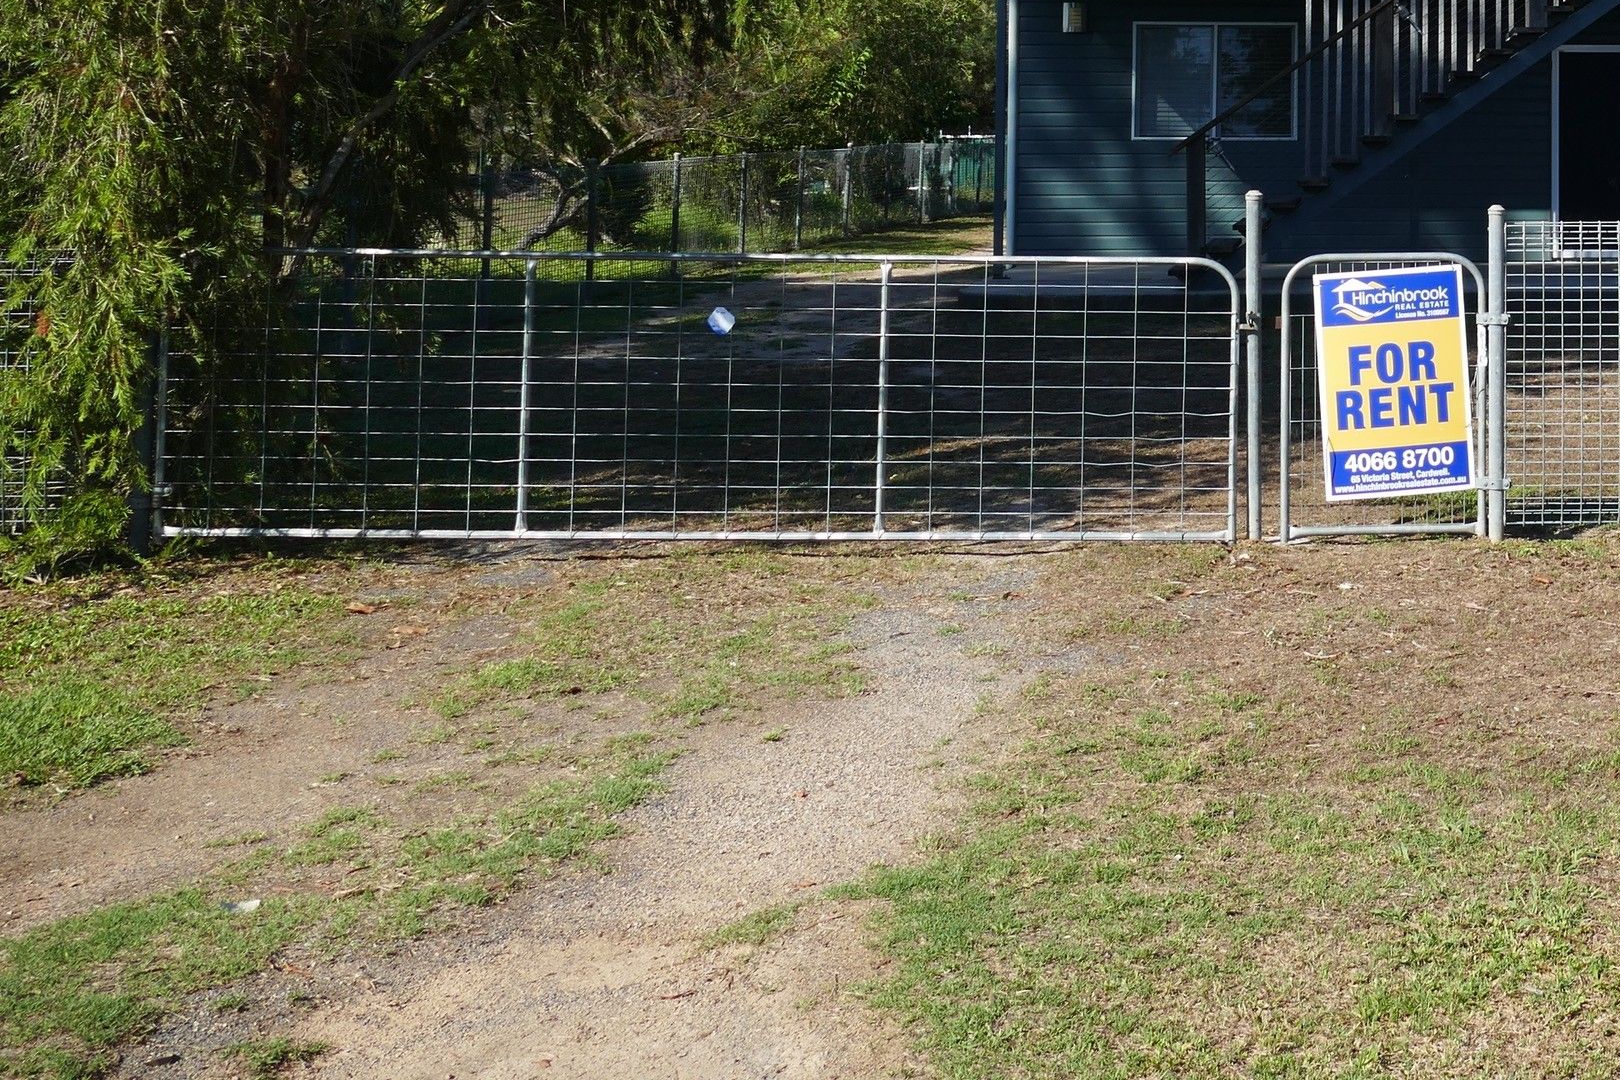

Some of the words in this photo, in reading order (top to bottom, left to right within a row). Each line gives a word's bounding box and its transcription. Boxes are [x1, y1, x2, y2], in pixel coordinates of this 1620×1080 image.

[1351, 285, 1449, 306] Hinchinbrook
[1394, 303, 1417, 311] REAL
[1419, 300, 1450, 309] ESTATE
[1348, 340, 1438, 386] FOR
[1335, 382, 1454, 431] RENT
[1344, 451, 1397, 472] 4066
[1402, 446, 1455, 468] 8700
[1334, 476, 1467, 494] www.hinchinbrookrealestate.com.au
[1360, 473, 1390, 483] Victoria
